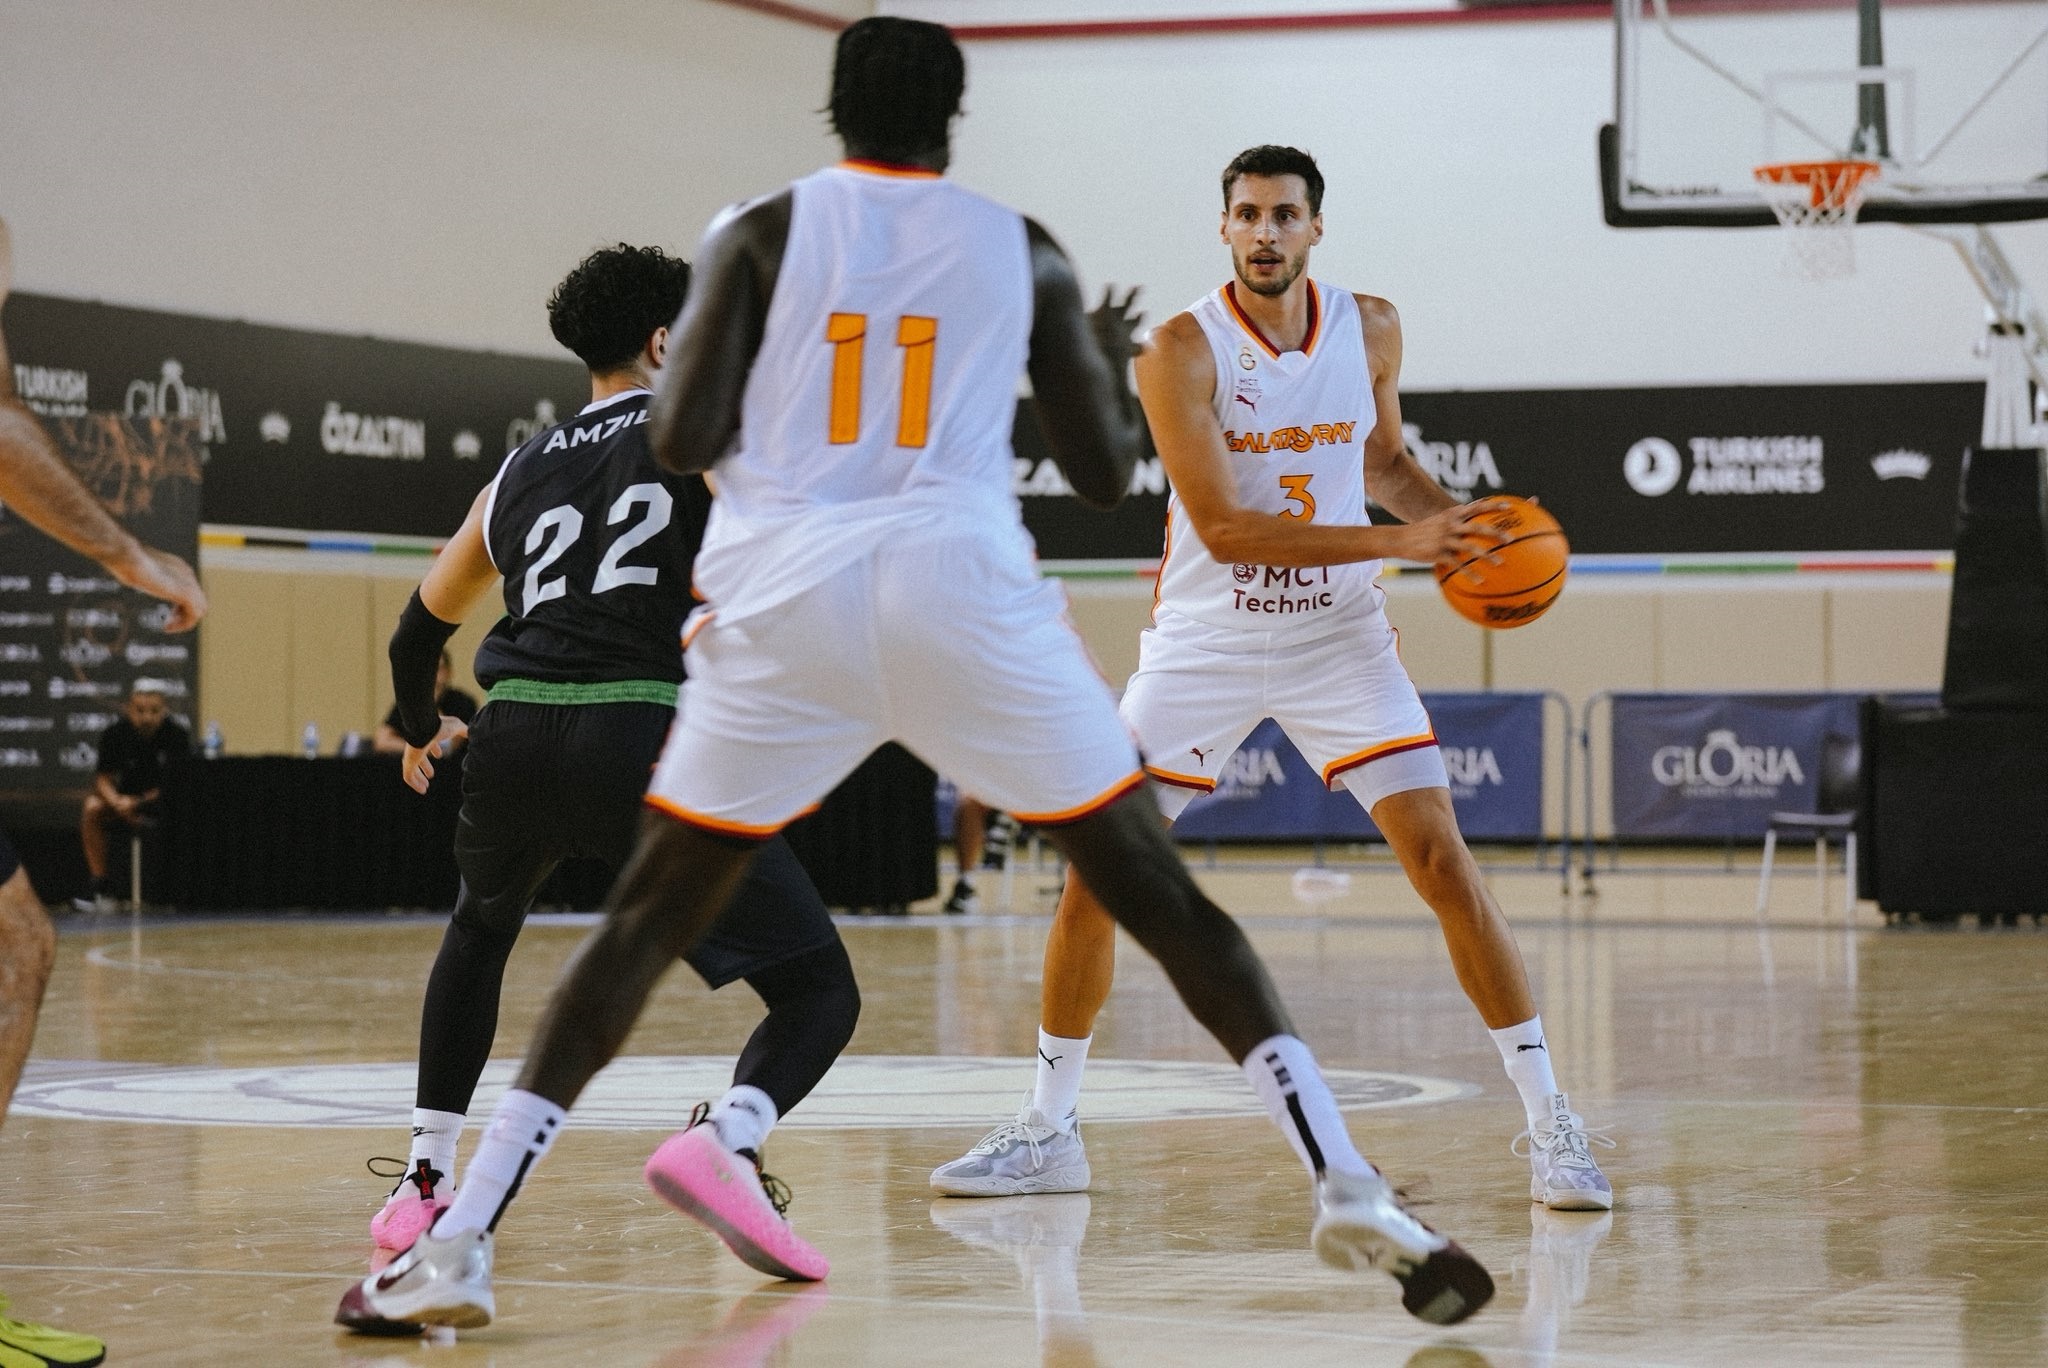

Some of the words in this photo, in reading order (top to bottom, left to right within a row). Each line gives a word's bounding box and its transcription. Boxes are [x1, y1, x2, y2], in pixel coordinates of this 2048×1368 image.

[825, 312, 939, 449] 11
[543, 409, 651, 454] AMZIL
[1223, 421, 1357, 453] GALATASARAY
[1688, 436, 1824, 464] TURKISH
[1402, 422, 1503, 490] RIA
[1277, 474, 1316, 524] 3
[1687, 464, 1825, 494] AIRLINES
[521, 482, 674, 618] 22
[1233, 588, 1333, 614] Technic
[1220, 748, 1286, 786] RIA
[1440, 747, 1503, 786] RIA
[1651, 728, 1805, 787] GLORIA
